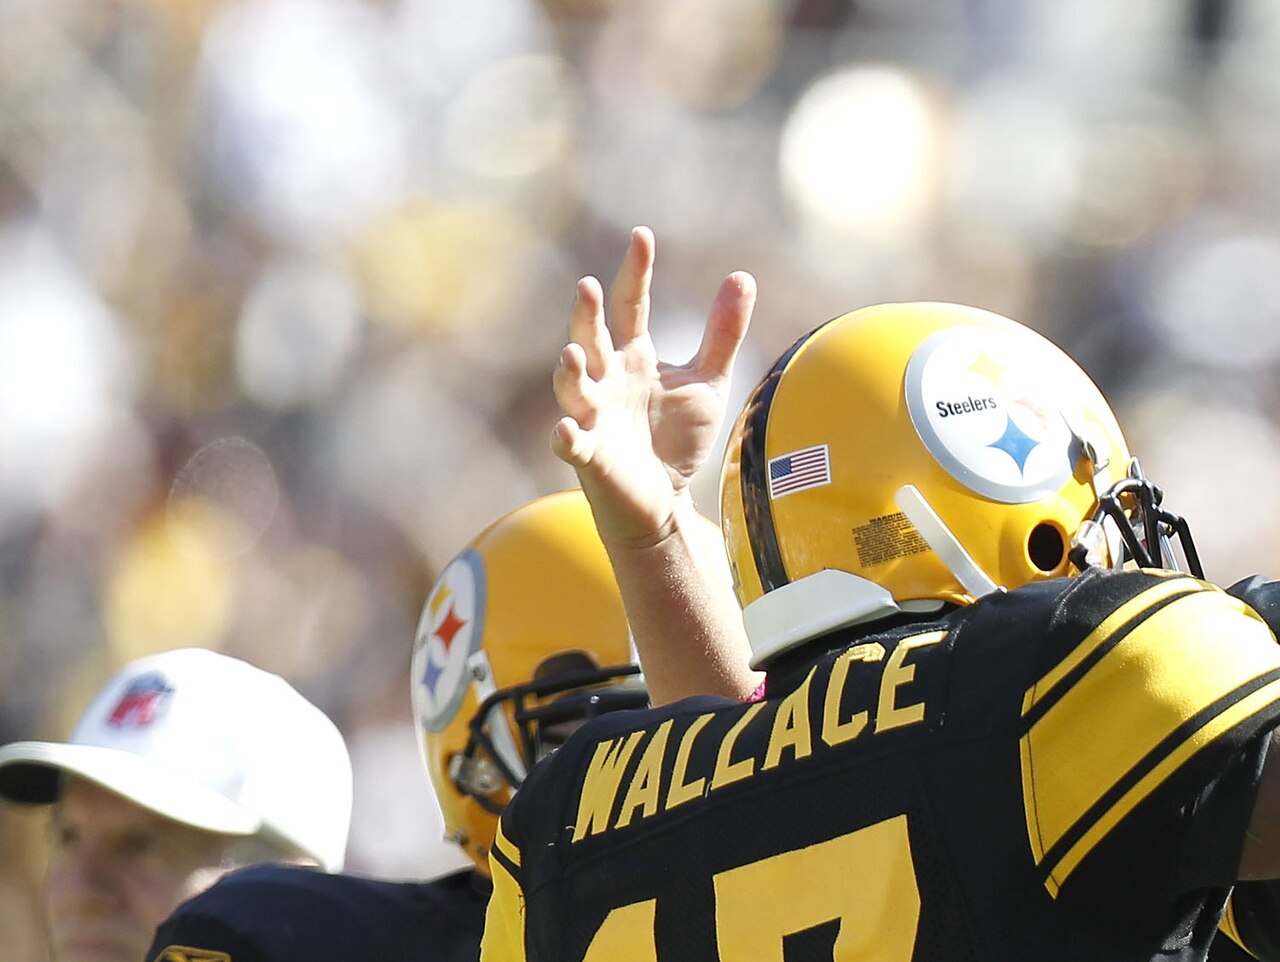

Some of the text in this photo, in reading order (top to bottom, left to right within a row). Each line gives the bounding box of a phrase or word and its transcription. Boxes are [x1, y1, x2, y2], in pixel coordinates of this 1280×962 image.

[935, 396, 997, 418] Steelers
[869, 511, 905, 523] WARNIN
[571, 630, 950, 844] WALLACE
